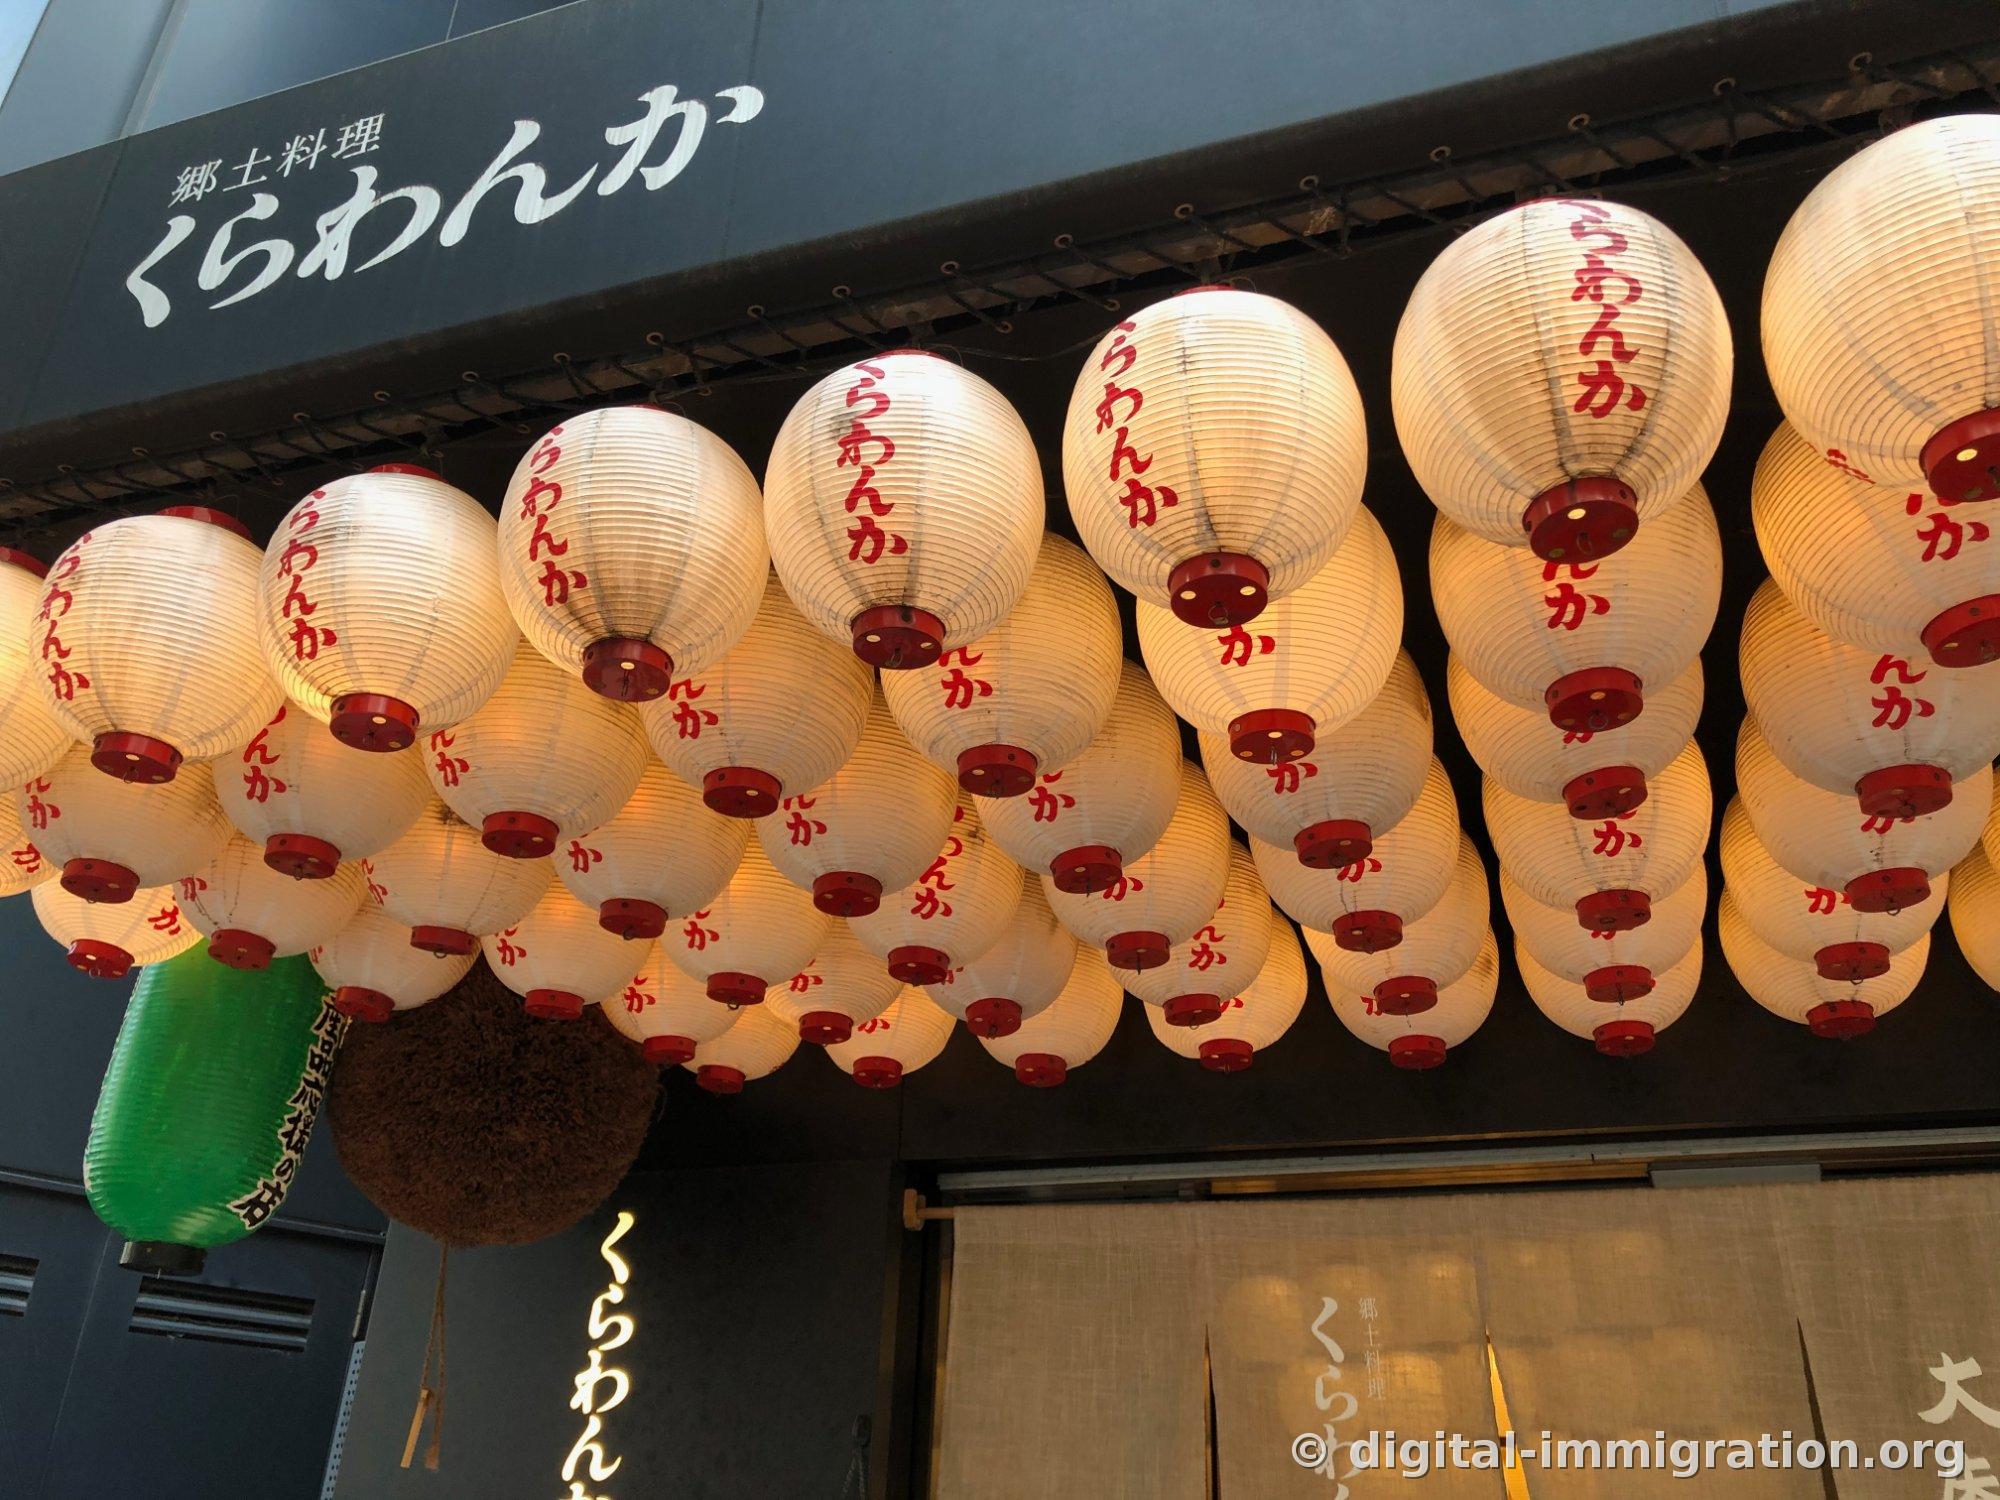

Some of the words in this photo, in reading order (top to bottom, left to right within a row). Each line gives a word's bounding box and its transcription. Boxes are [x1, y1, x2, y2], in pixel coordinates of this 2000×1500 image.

[126, 84, 764, 329] くらわんか
[168, 113, 385, 208] 郷土料理
[277, 490, 337, 661] らわんか
[520, 424, 588, 606] らわんか
[39, 532, 90, 700] らわんか
[1310, 1296, 1367, 1500] くらわ
